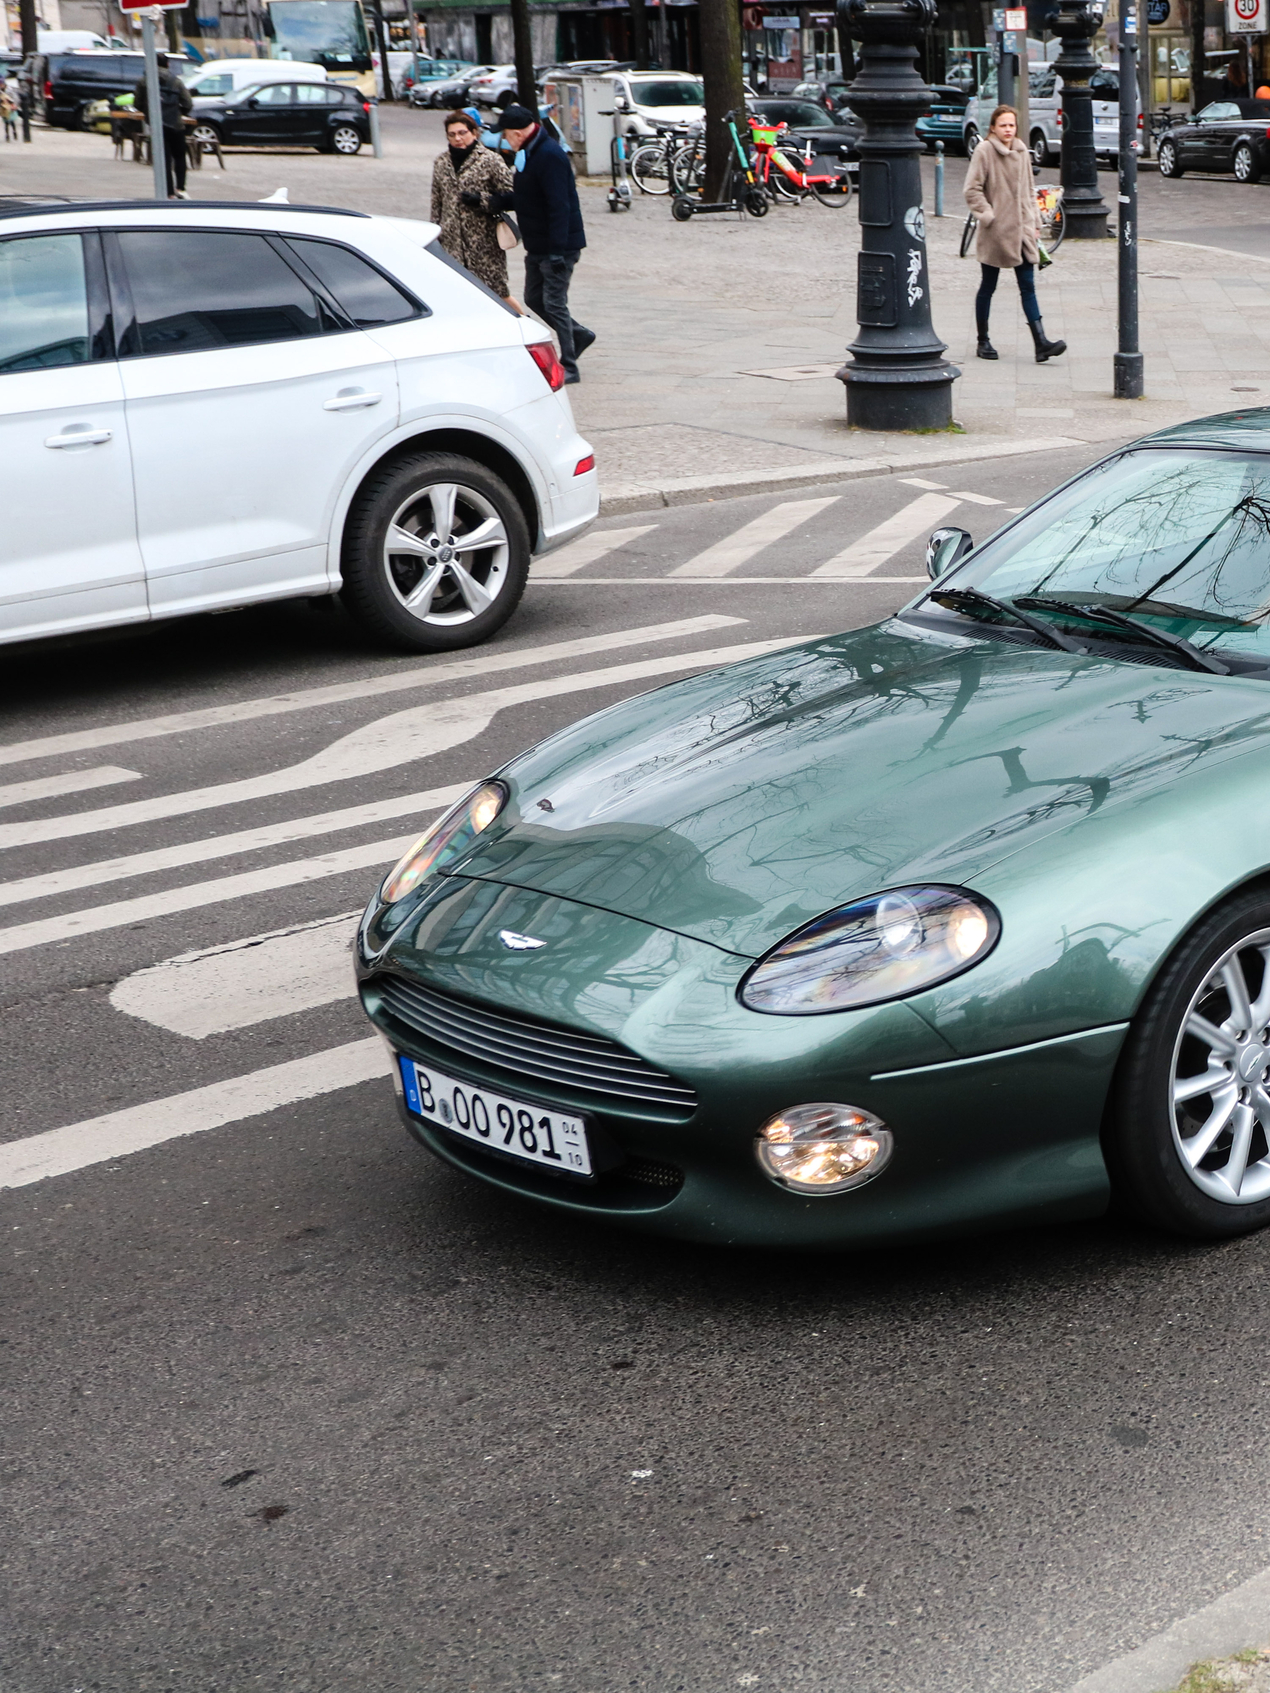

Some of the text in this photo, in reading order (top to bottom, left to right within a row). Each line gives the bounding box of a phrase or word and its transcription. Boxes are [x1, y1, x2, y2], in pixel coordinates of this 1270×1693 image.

[1240, 0, 1254, 12] 30
[1238, 22, 1257, 30] ZONE
[417, 1070, 436, 1113] B
[497, 1103, 562, 1161] 981
[562, 1121, 578, 1136] 04
[568, 1152, 583, 1166] 10
